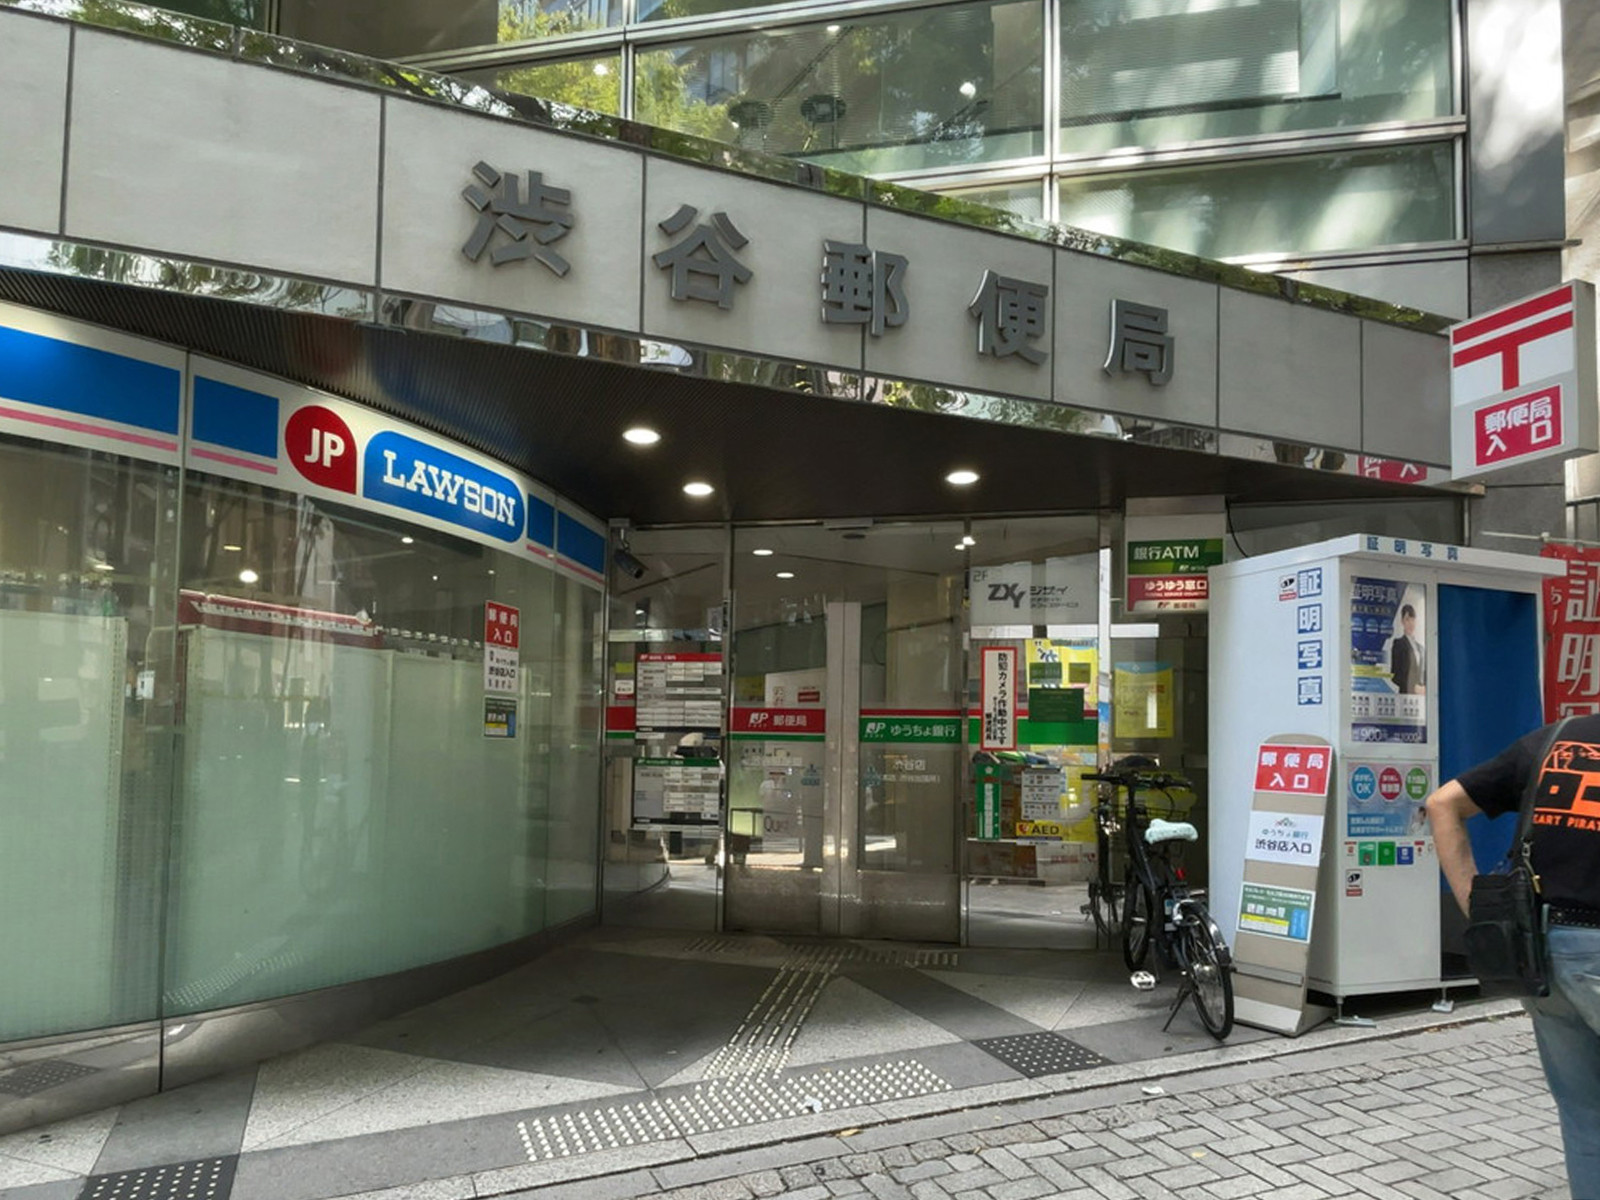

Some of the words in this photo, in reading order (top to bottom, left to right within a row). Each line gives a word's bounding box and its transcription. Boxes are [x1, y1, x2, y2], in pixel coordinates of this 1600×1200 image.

[462, 160, 1177, 387] 渋谷郵便局
[1484, 396, 1553, 435] 郵便局
[304, 428, 345, 468] JP
[1485, 420, 1553, 457] 入口
[383, 449, 516, 527] LAWSON
[1133, 545, 1199, 560] 銀行ATM
[1367, 536, 1459, 561] 証明写真
[1298, 567, 1322, 705] 証明写真
[890, 724, 957, 737] ゆうちょ銀行
[1261, 752, 1324, 770] 郵便局
[1270, 773, 1309, 789] 入口
[1356, 783, 1371, 794] OK
[1032, 825, 1060, 835] AED
[1255, 838, 1312, 854] 渋谷店入口
